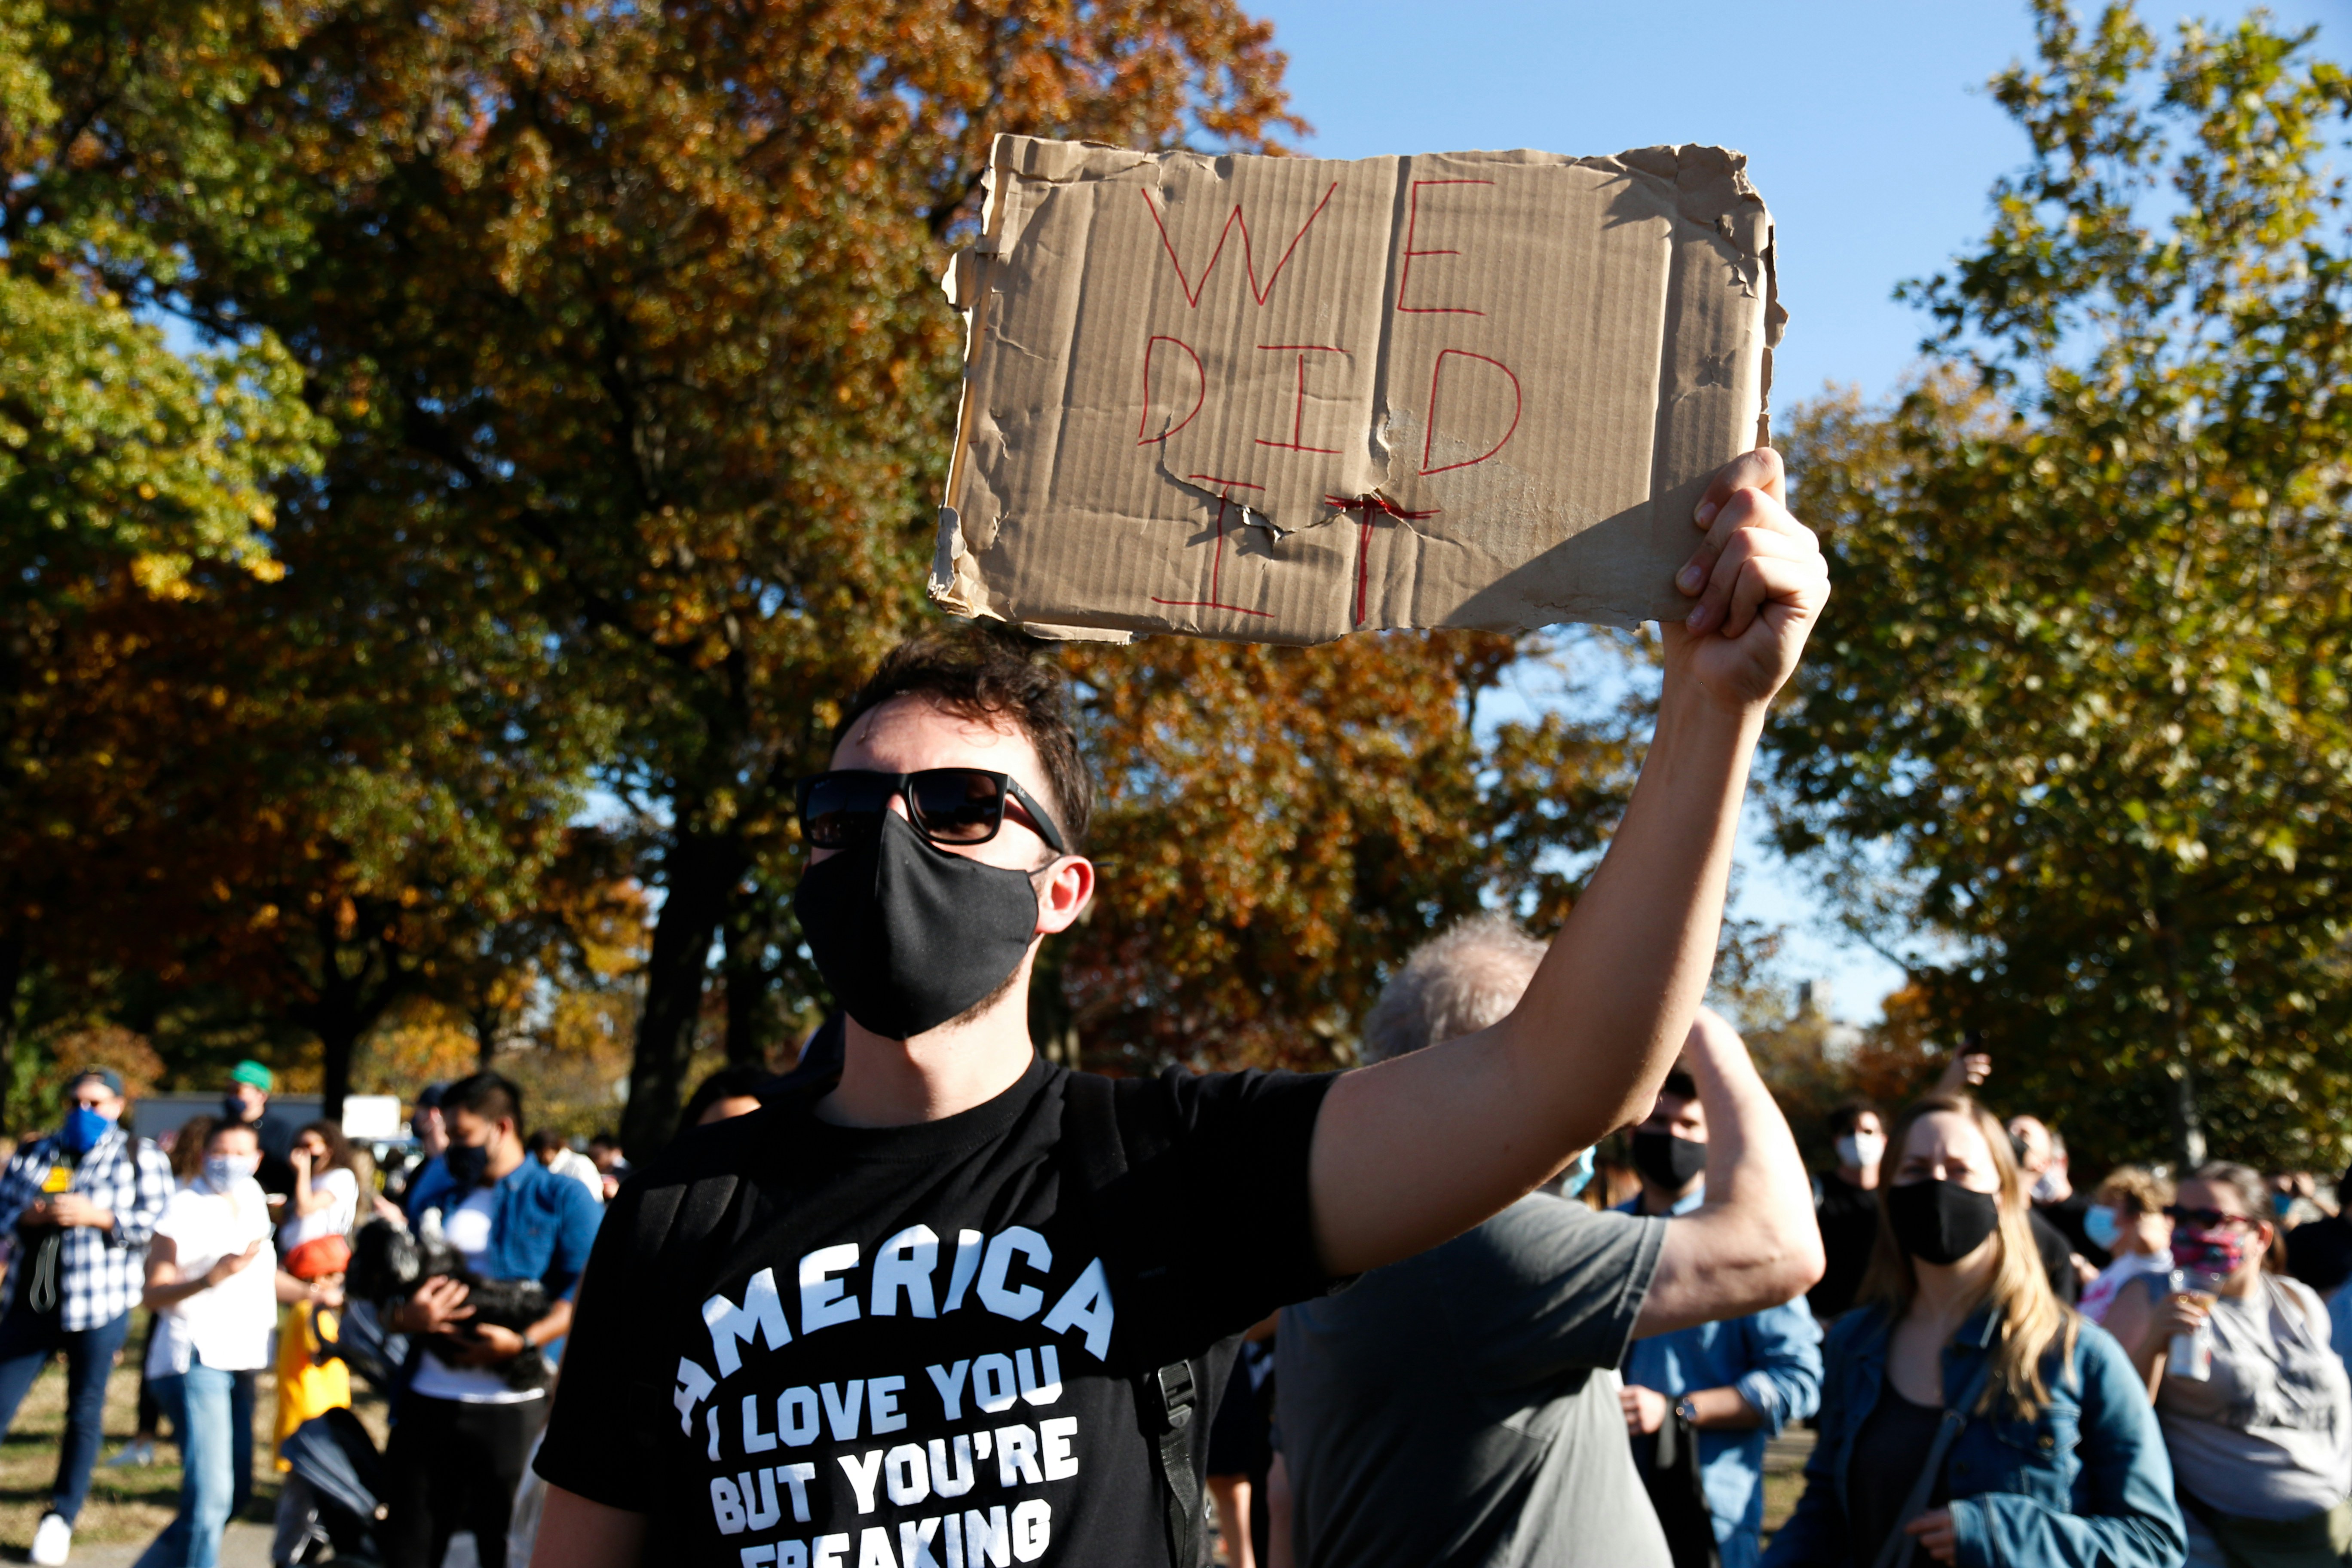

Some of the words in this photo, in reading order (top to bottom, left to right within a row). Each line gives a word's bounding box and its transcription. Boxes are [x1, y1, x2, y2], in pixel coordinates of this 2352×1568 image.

[1141, 180, 1494, 316] WE
[1139, 336, 1521, 475] DID
[1152, 475, 1440, 626] IT
[674, 1224, 1114, 1436] AMERICA
[707, 1406, 721, 1461] I
[742, 1376, 906, 1454] LOVE
[925, 1344, 1063, 1421] YOU
[710, 1462, 816, 1534] BUT
[837, 1416, 1079, 1514] YOU'RE
